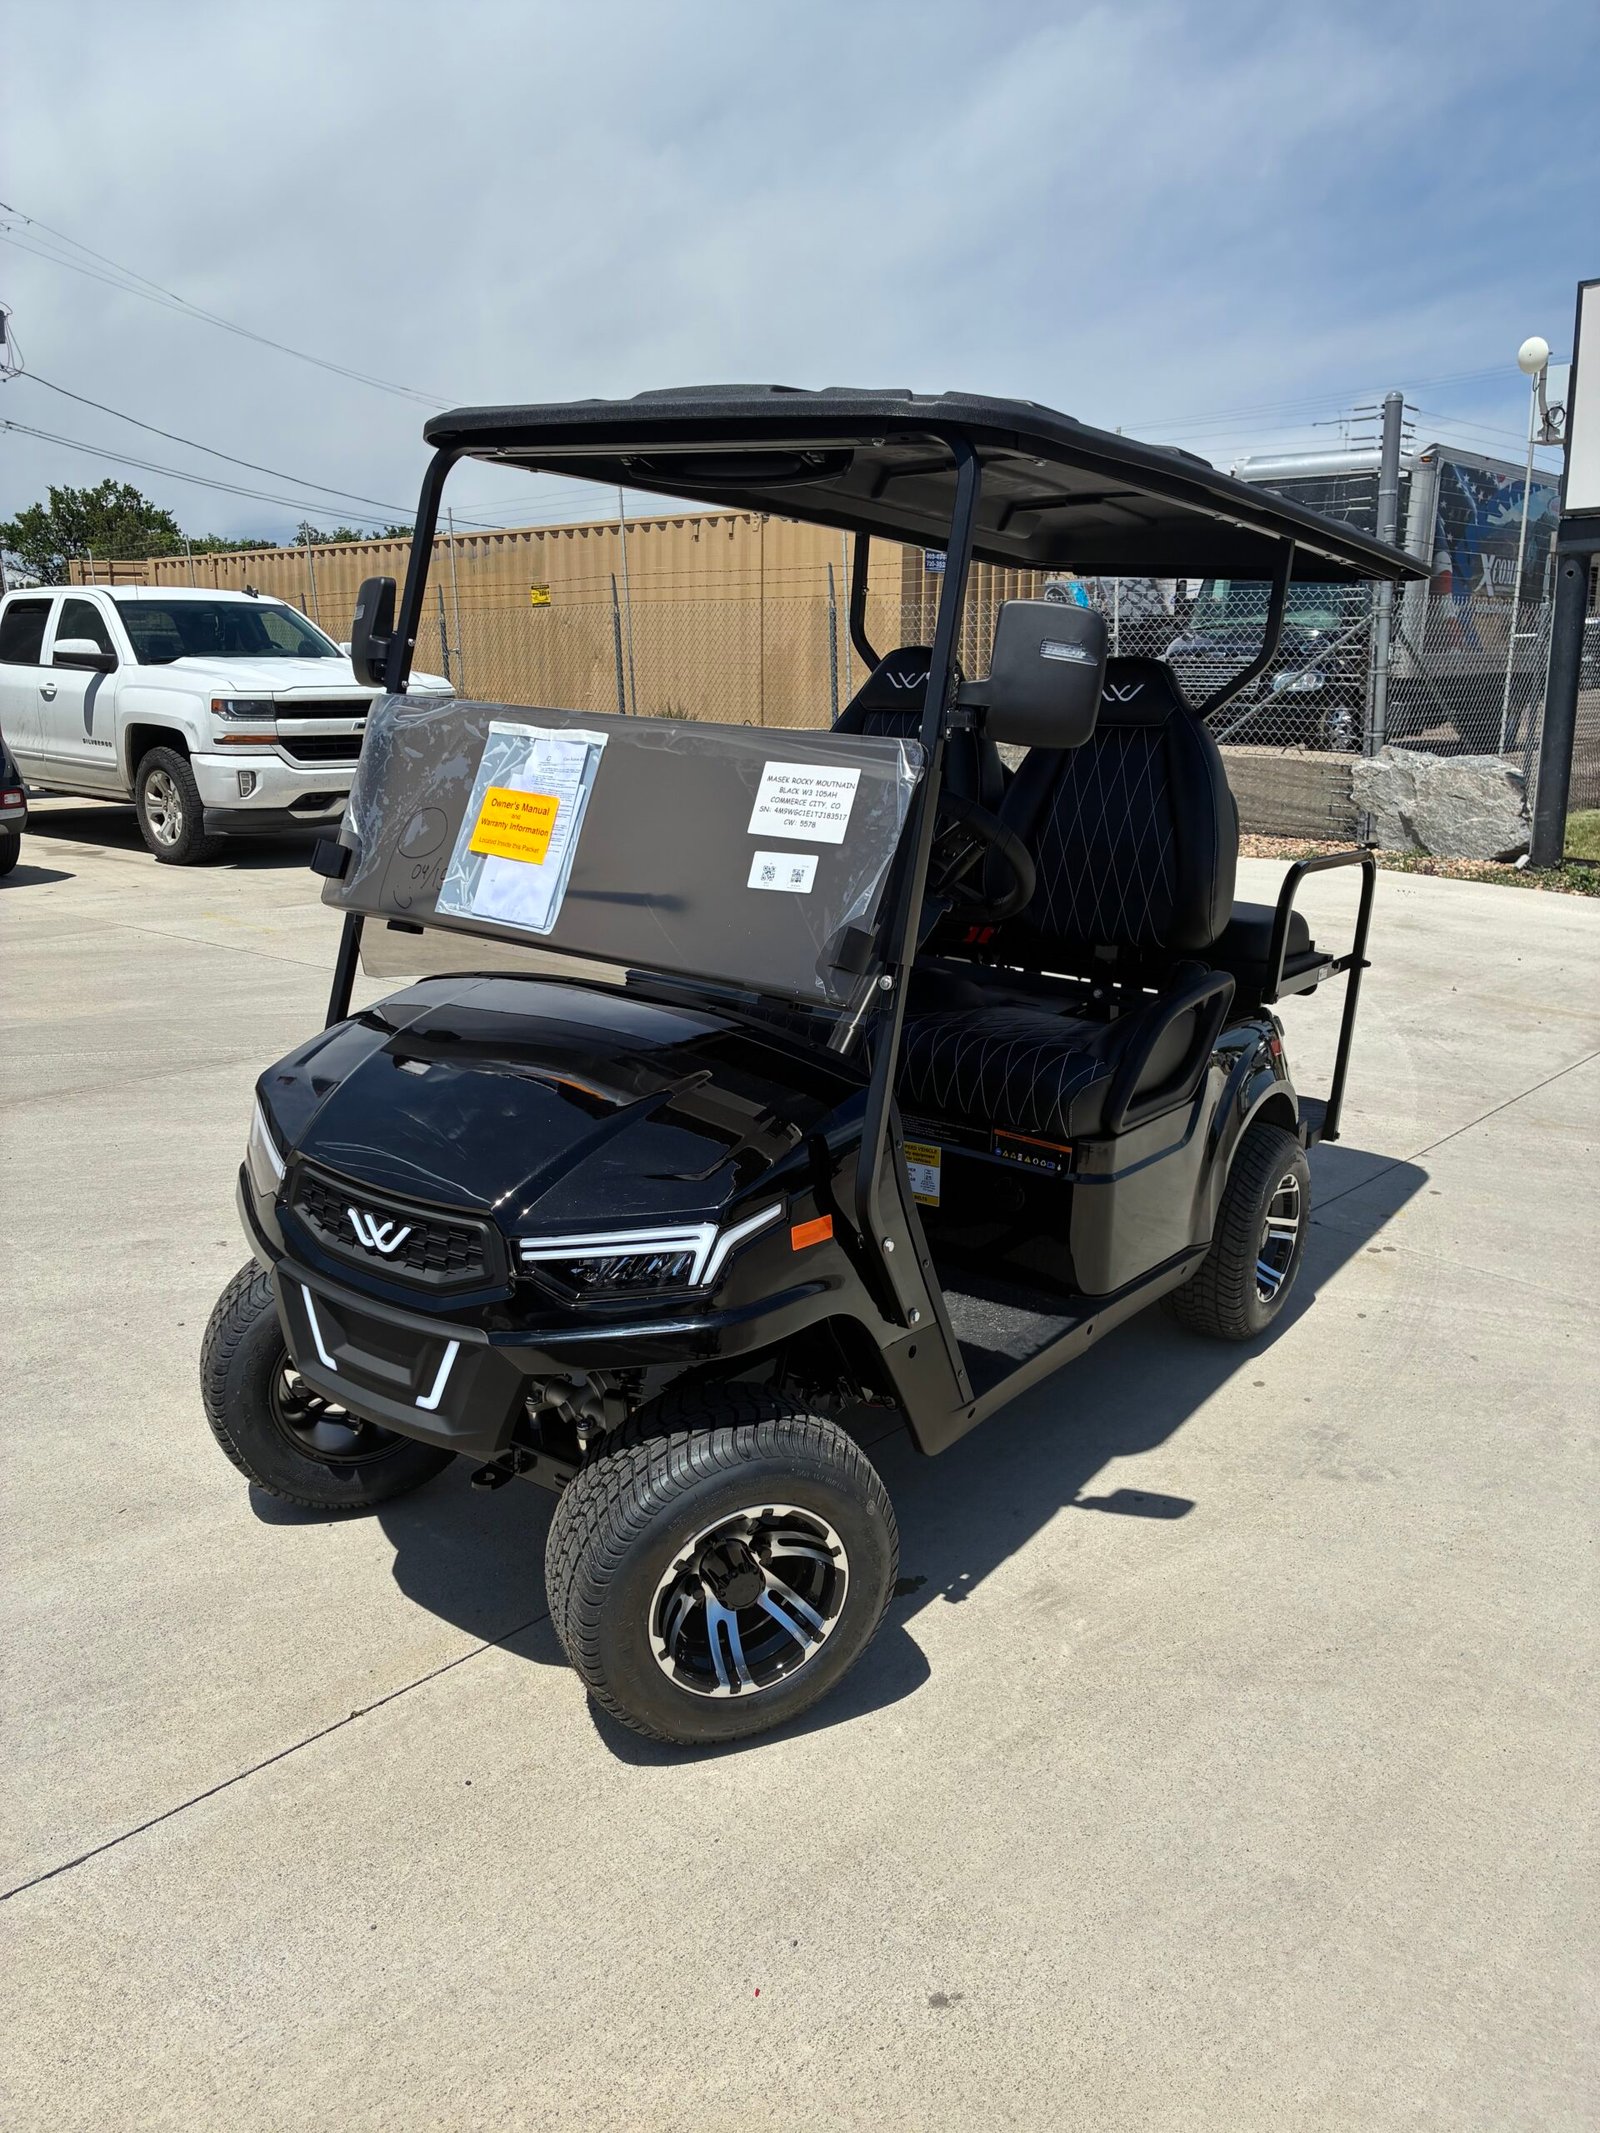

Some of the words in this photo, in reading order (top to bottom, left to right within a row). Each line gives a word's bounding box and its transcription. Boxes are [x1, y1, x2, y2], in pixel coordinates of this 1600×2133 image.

[766, 775, 791, 784] MASEK
[791, 776, 814, 786] ROCKY
[815, 779, 856, 790] MOUTNAIN
[778, 786, 800, 795] BLACK
[801, 788, 813, 796] W3
[815, 789, 838, 799] 105AH
[491, 798, 520, 811] Owner's
[521, 803, 550, 816] Manual
[759, 805, 772, 813] SN:
[770, 796, 807, 807] COMMERCE
[830, 801, 841, 810] CO
[481, 817, 509, 830] Warranty
[509, 822, 549, 837] Information
[783, 818, 797, 827] CW:
[799, 819, 817, 829] 5578
[479, 836, 497, 845] Located
[512, 842, 521, 850] this
[521, 844, 540, 854] Packet
